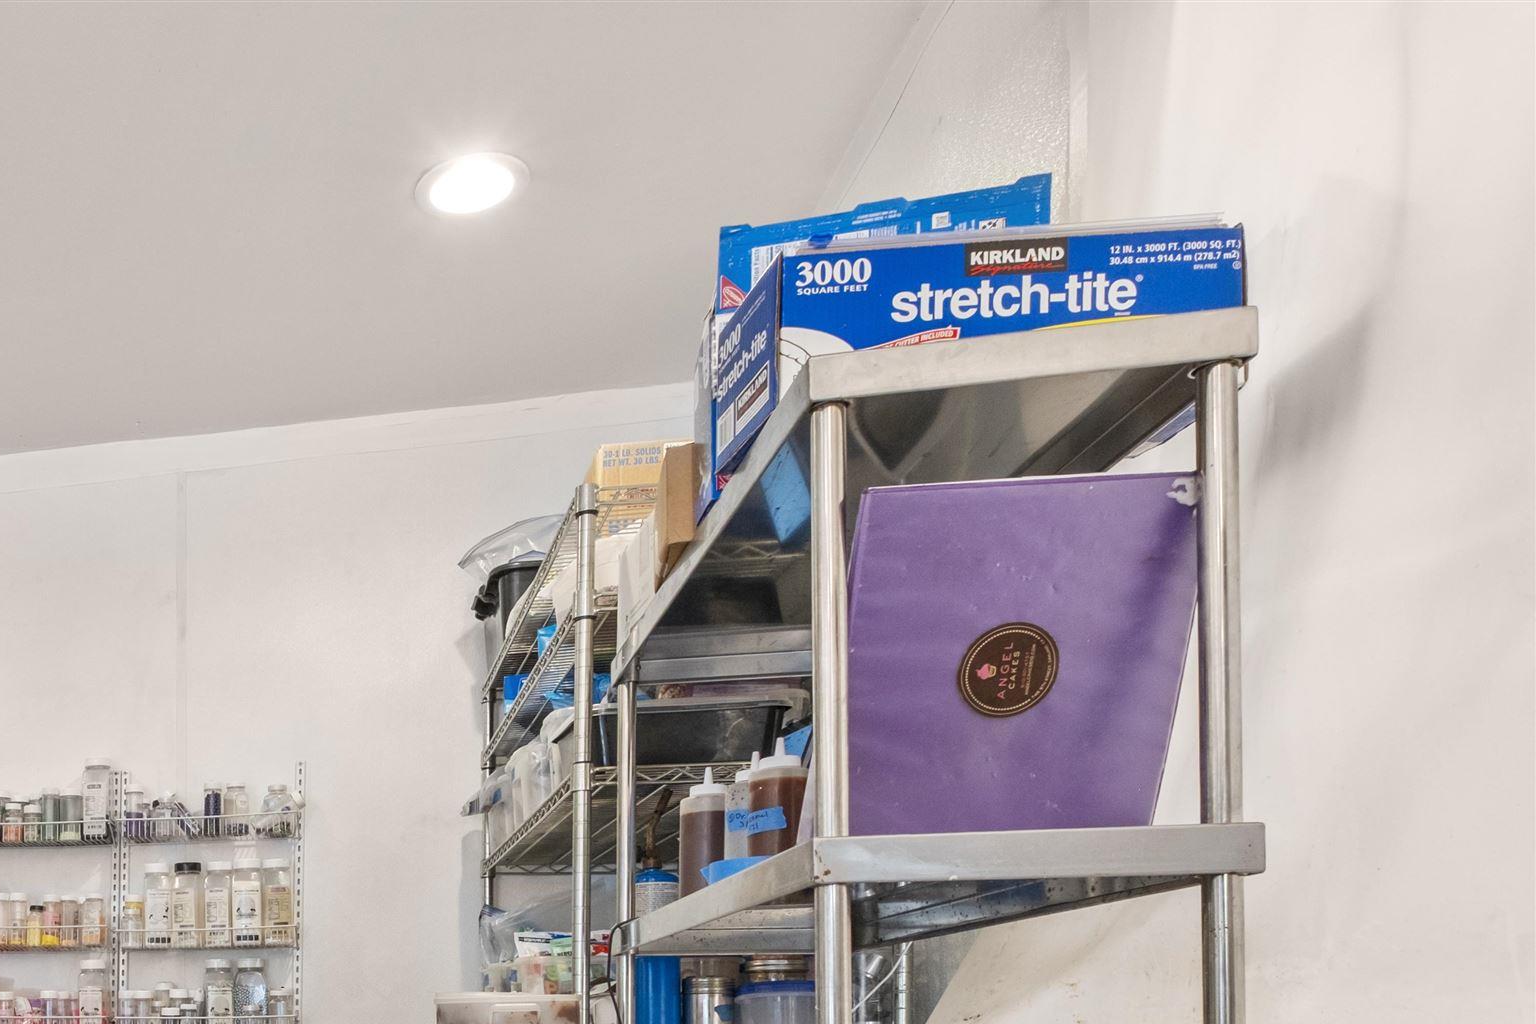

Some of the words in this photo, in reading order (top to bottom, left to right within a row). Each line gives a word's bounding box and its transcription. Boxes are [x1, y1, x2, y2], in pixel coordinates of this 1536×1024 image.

[970, 245, 1065, 266] KIRKLAND
[1110, 245, 1120, 254] 12
[1145, 243, 1166, 252] 3000
[1168, 242, 1181, 251] FT.
[1183, 241, 1207, 252] (3000
[1210, 240, 1224, 250] SQ.
[1109, 256, 1133, 266] 30.48
[1158, 253, 1181, 263] 914.4
[1194, 251, 1221, 262] (278.7
[796, 258, 872, 288] 3000
[969, 260, 1064, 276] Signature
[797, 285, 840, 296] SQUARE
[844, 284, 869, 294] FEET
[718, 322, 741, 367] 3000
[920, 329, 954, 342] INCLUDED
[736, 368, 768, 412] KIRKLAND
[636, 447, 661, 455] SOLIDS
[996, 641, 1014, 700] ANGEL
[1008, 650, 1021, 690] CAKES
